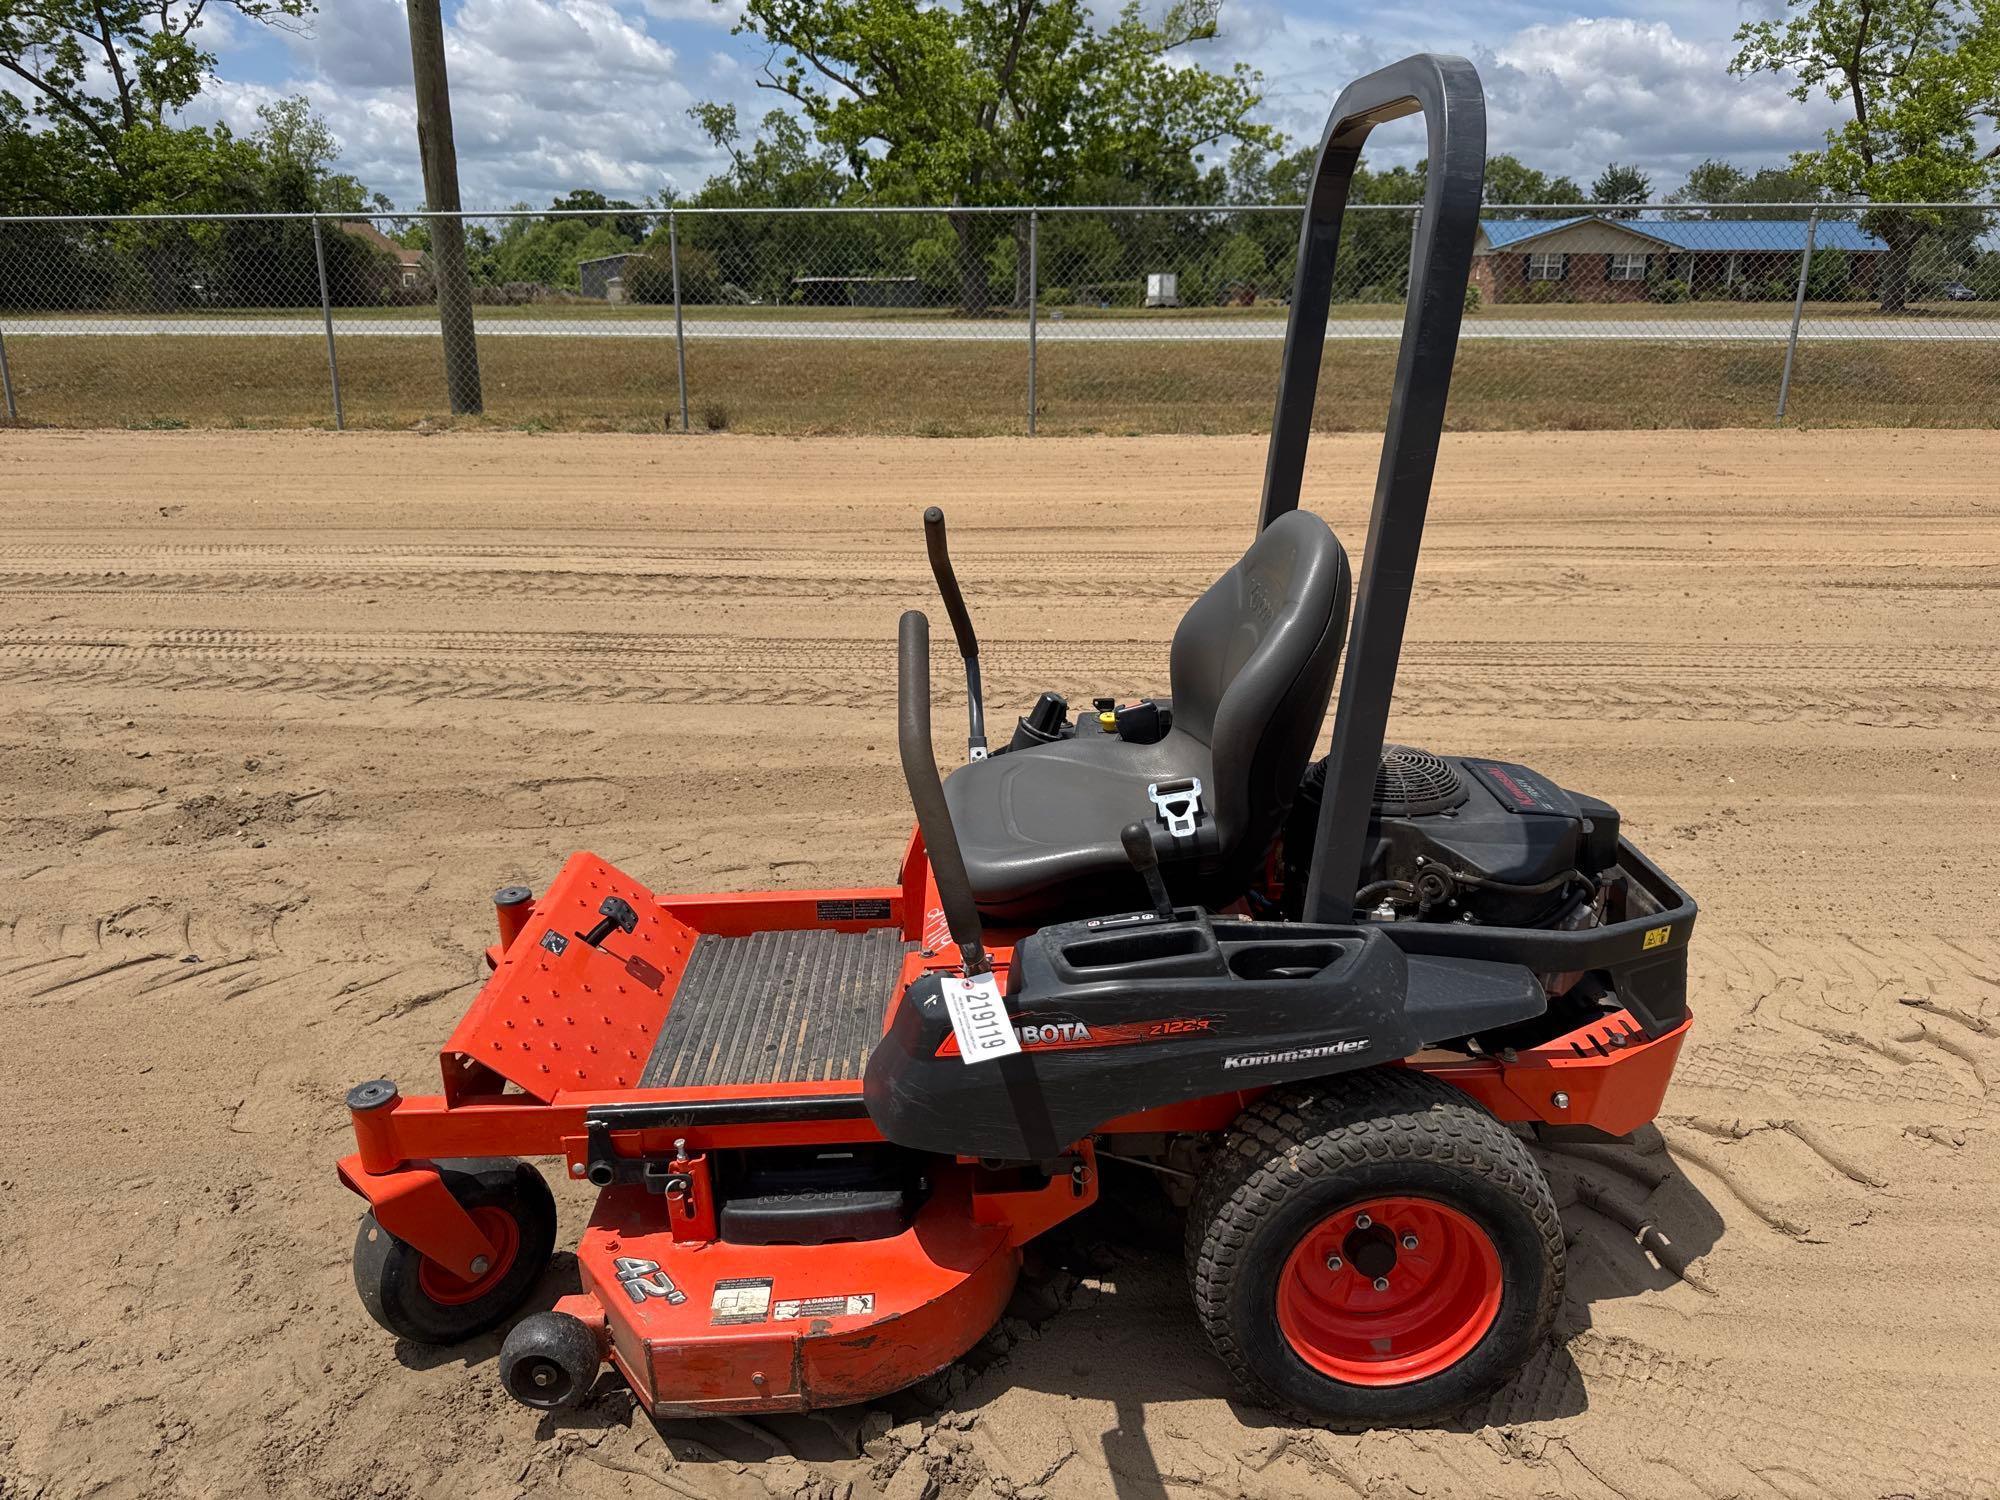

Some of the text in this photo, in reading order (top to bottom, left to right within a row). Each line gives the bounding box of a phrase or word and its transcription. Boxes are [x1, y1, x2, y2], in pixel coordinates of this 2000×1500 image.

[966, 992, 1006, 1049] 219119
[1014, 1022, 1092, 1043] BOTA
[1223, 1039, 1370, 1069] Kommander
[811, 1296, 845, 1304] DANGER
